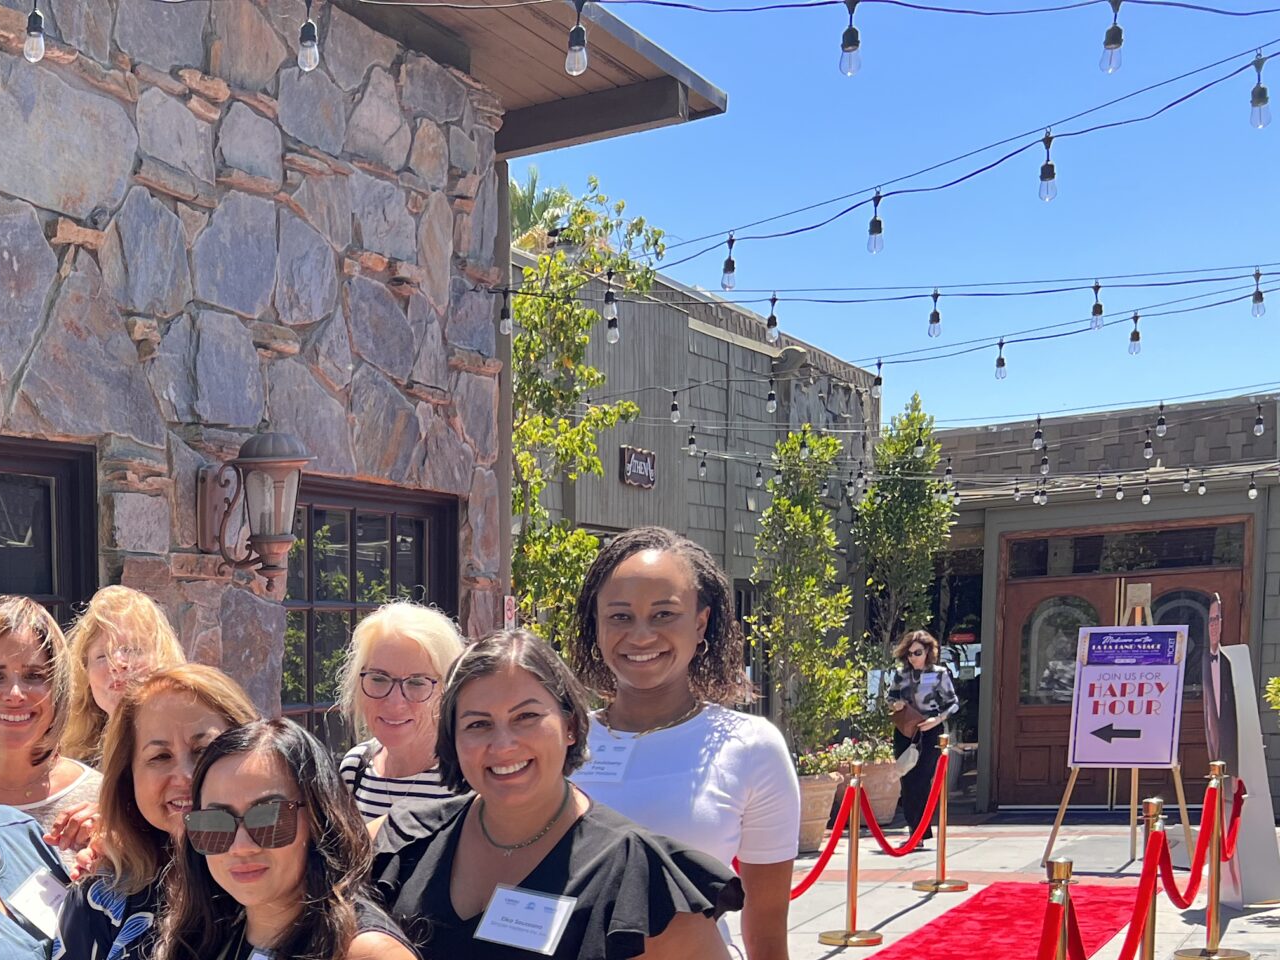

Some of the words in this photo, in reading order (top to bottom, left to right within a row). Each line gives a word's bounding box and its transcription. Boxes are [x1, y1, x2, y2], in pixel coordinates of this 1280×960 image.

[1097, 672, 1121, 681] JOIN
[1124, 672, 1137, 681] US
[1140, 672, 1161, 680] FOR
[1088, 682, 1169, 698] HAPPY
[1092, 700, 1162, 715] HOUR
